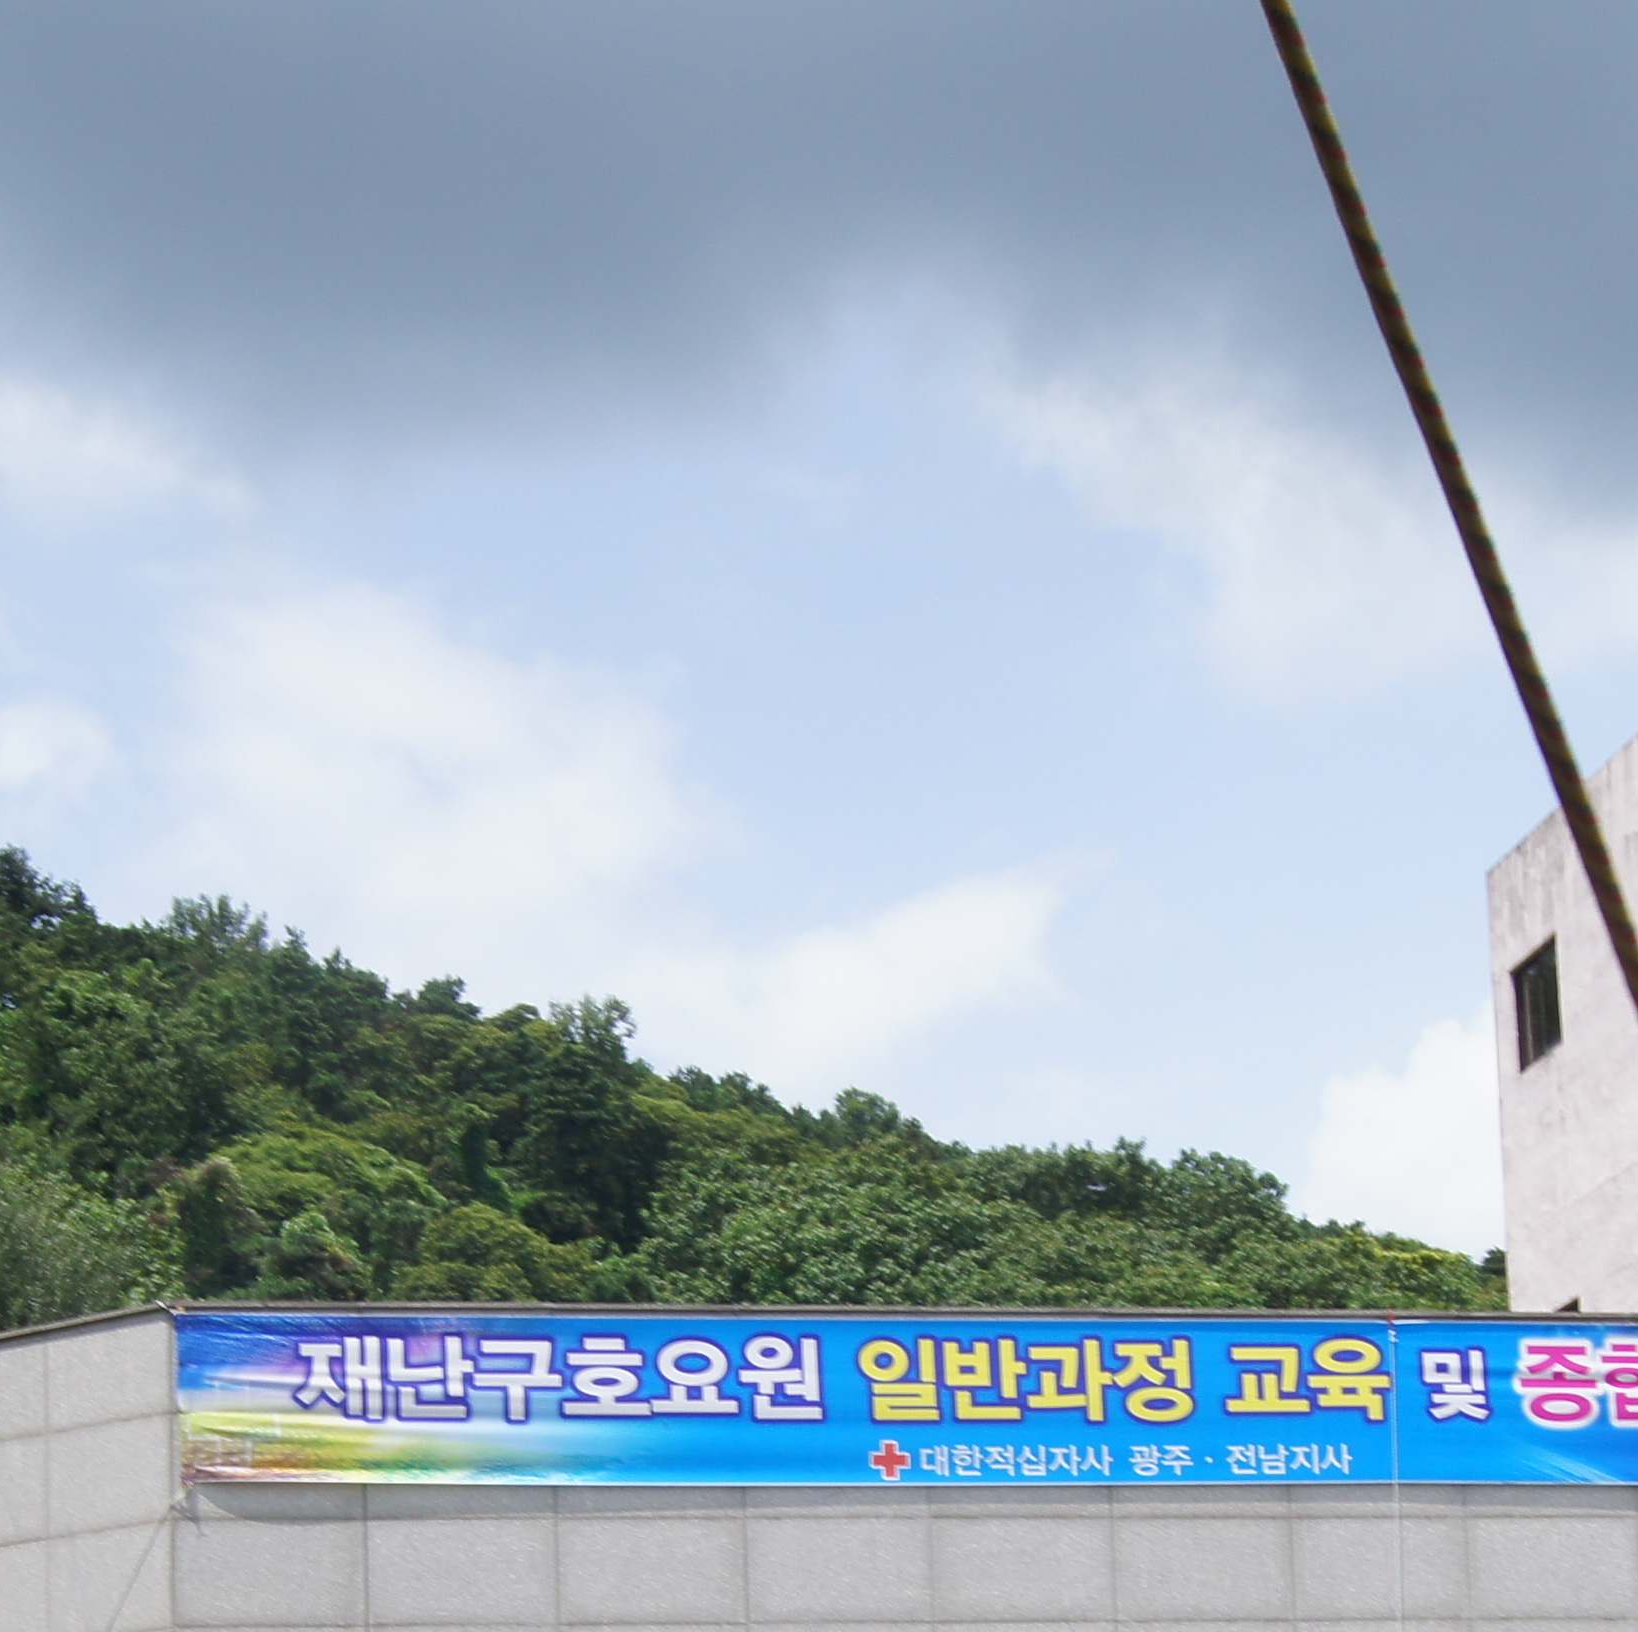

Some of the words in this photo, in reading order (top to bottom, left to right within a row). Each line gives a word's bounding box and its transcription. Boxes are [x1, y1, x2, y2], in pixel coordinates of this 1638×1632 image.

[294, 1334, 826, 1422] 재난구호요원
[855, 1335, 1197, 1423] 일반과정
[1223, 1336, 1393, 1421] 교육
[1419, 1347, 1491, 1423] 및
[919, 1444, 1114, 1477] 대한적십자사
[1128, 1444, 1195, 1475] 광주
[1225, 1442, 1354, 1475] 전남지사
